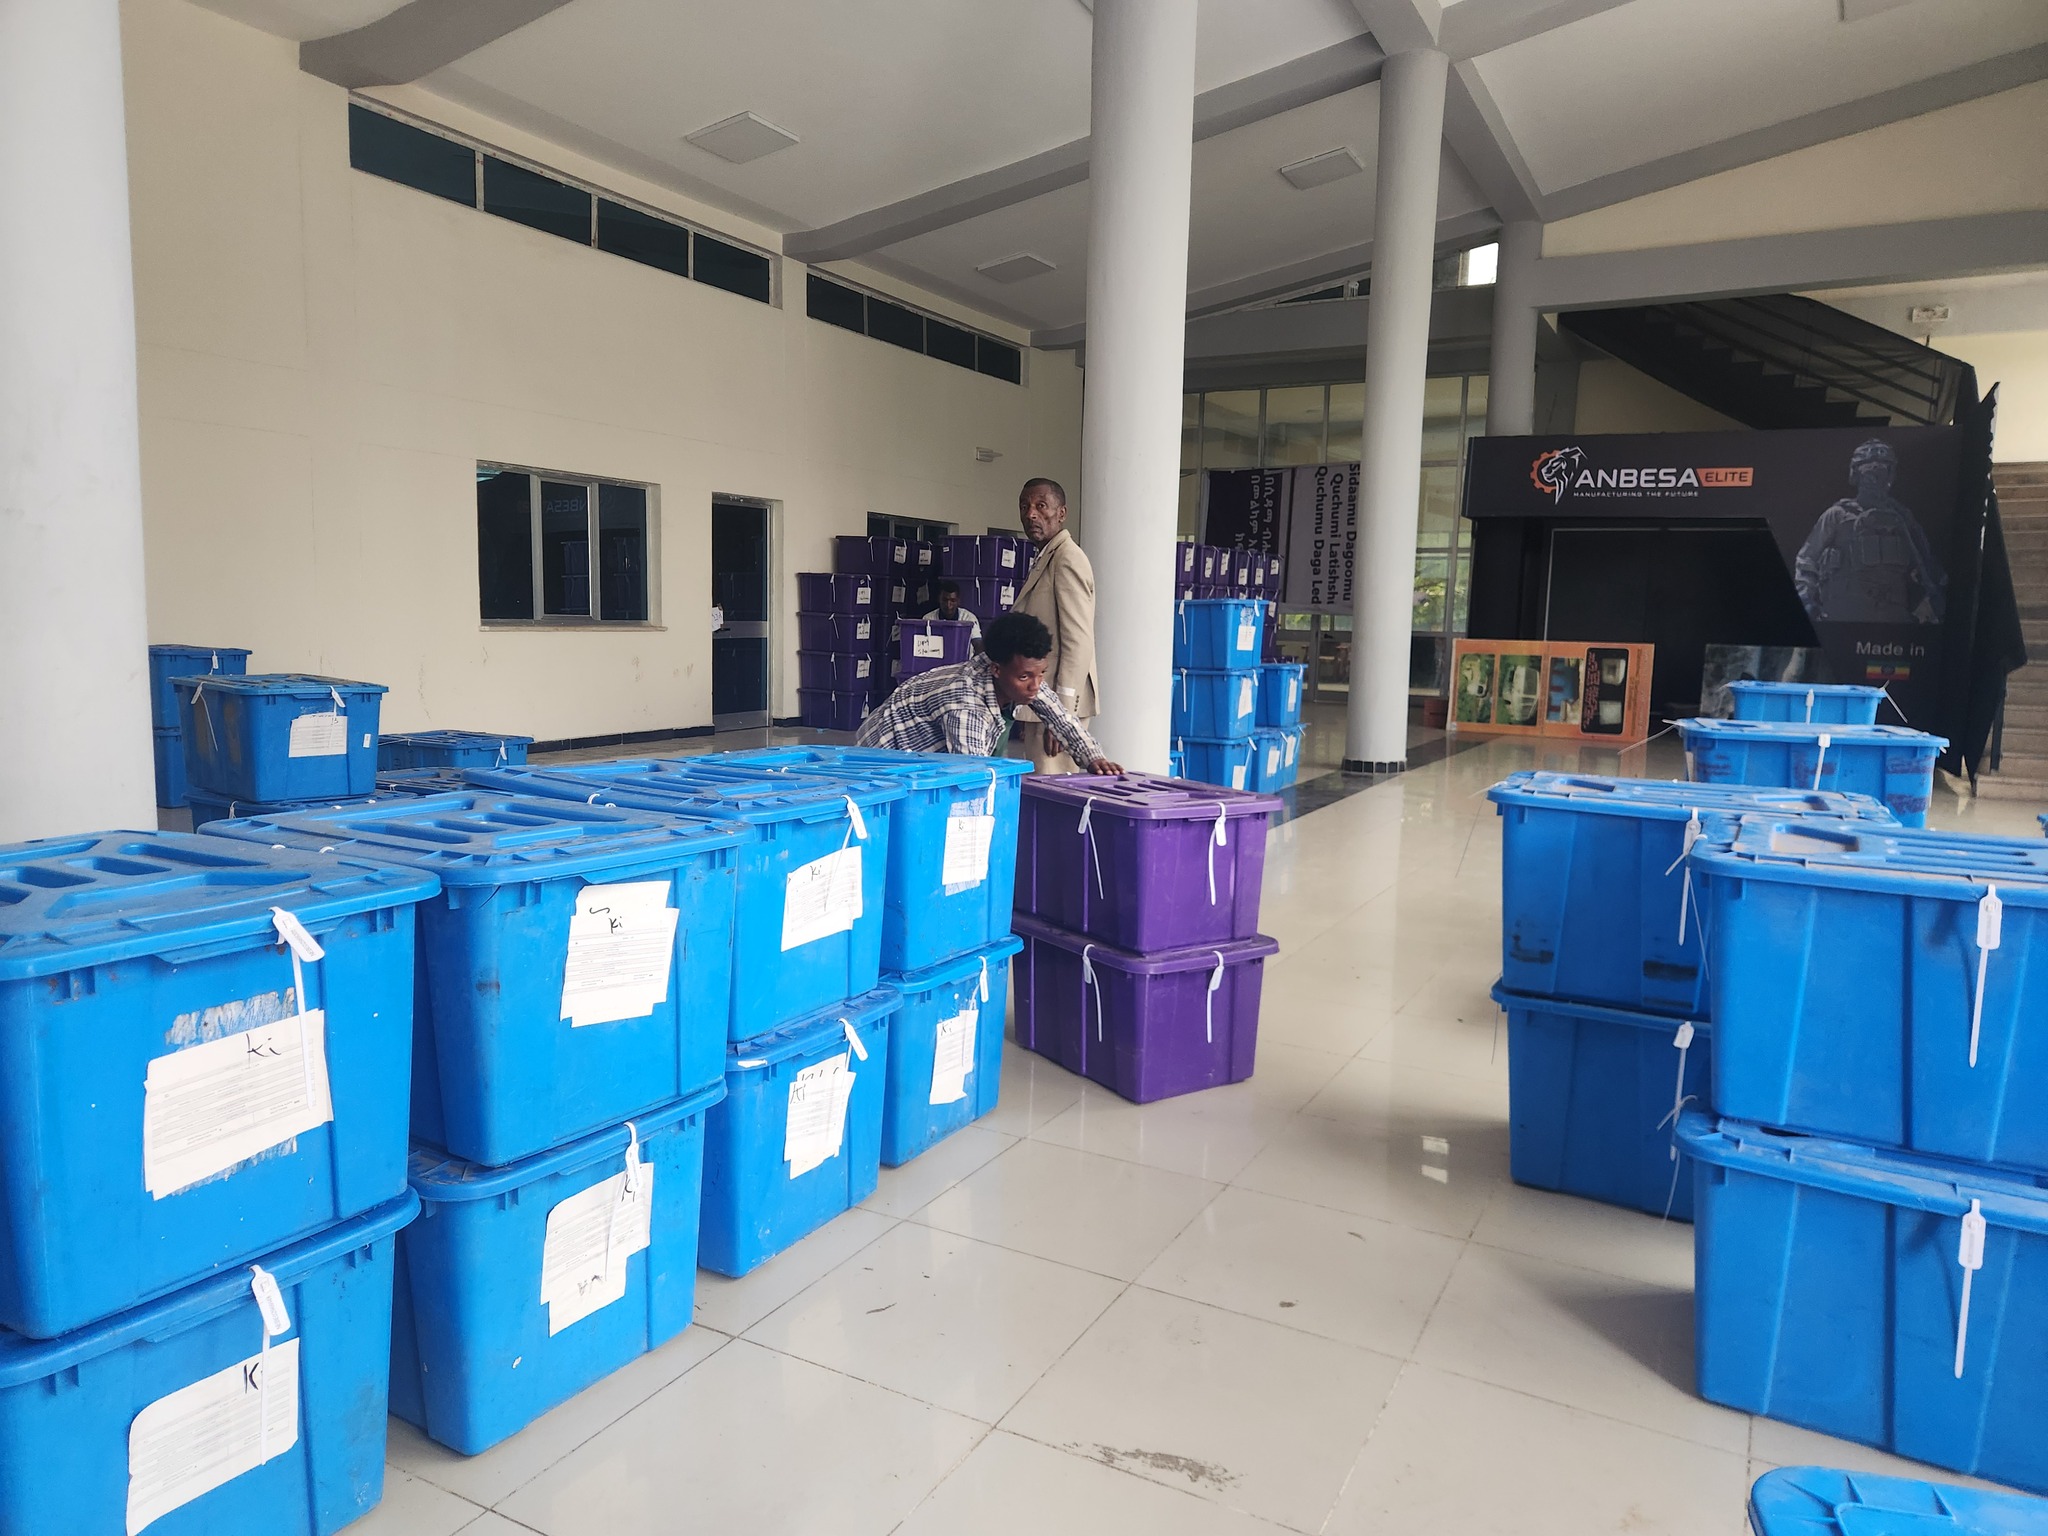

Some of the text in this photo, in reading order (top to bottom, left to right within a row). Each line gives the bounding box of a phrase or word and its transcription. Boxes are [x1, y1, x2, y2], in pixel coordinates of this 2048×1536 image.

[1315, 465, 1328, 535] Quchumu
[1574, 467, 1749, 488] ANBESA ELITE
[1330, 472, 1343, 538] Quchumi
[1310, 539, 1324, 575] Daga
[1342, 531, 1357, 600] Dagoomu
[1856, 641, 1925, 657] Made in
